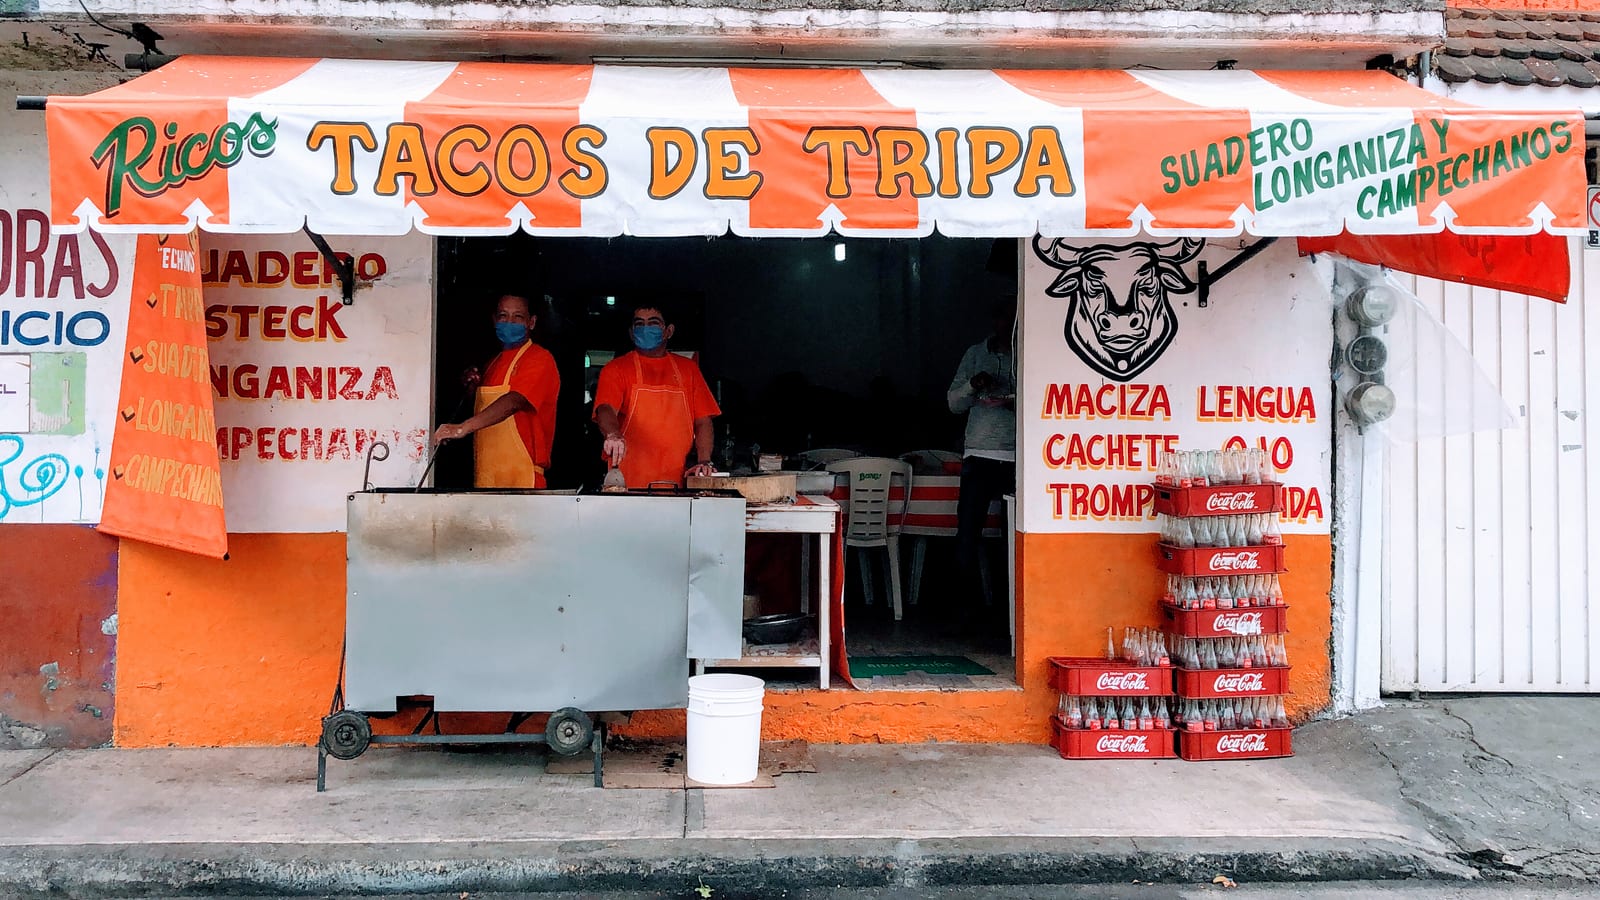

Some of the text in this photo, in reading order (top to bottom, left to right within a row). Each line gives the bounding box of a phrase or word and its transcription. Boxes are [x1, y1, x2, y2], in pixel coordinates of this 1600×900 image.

[90, 111, 278, 218] Ricos
[306, 121, 1077, 200] TACOS DE TRIPA
[1161, 118, 1313, 195] SUADERO
[1253, 118, 1451, 212] LONGANIZA Y
[1356, 119, 1573, 221] CAMPECHANOS
[1, 310, 111, 347] ICIO
[0, 384, 17, 394] L
[1041, 383, 1172, 421] MACIZA
[1197, 385, 1317, 423] LENGUA
[1046, 483, 1157, 522] TROMP
[1207, 491, 1257, 511] Coca-Cola
[1209, 551, 1260, 571] Coca-Cola
[1096, 672, 1150, 690] Coca-Cola
[1213, 673, 1265, 692] Coca-Cola
[1096, 735, 1150, 753] Coca-Cola
[1216, 733, 1269, 753] Coca-Cola
